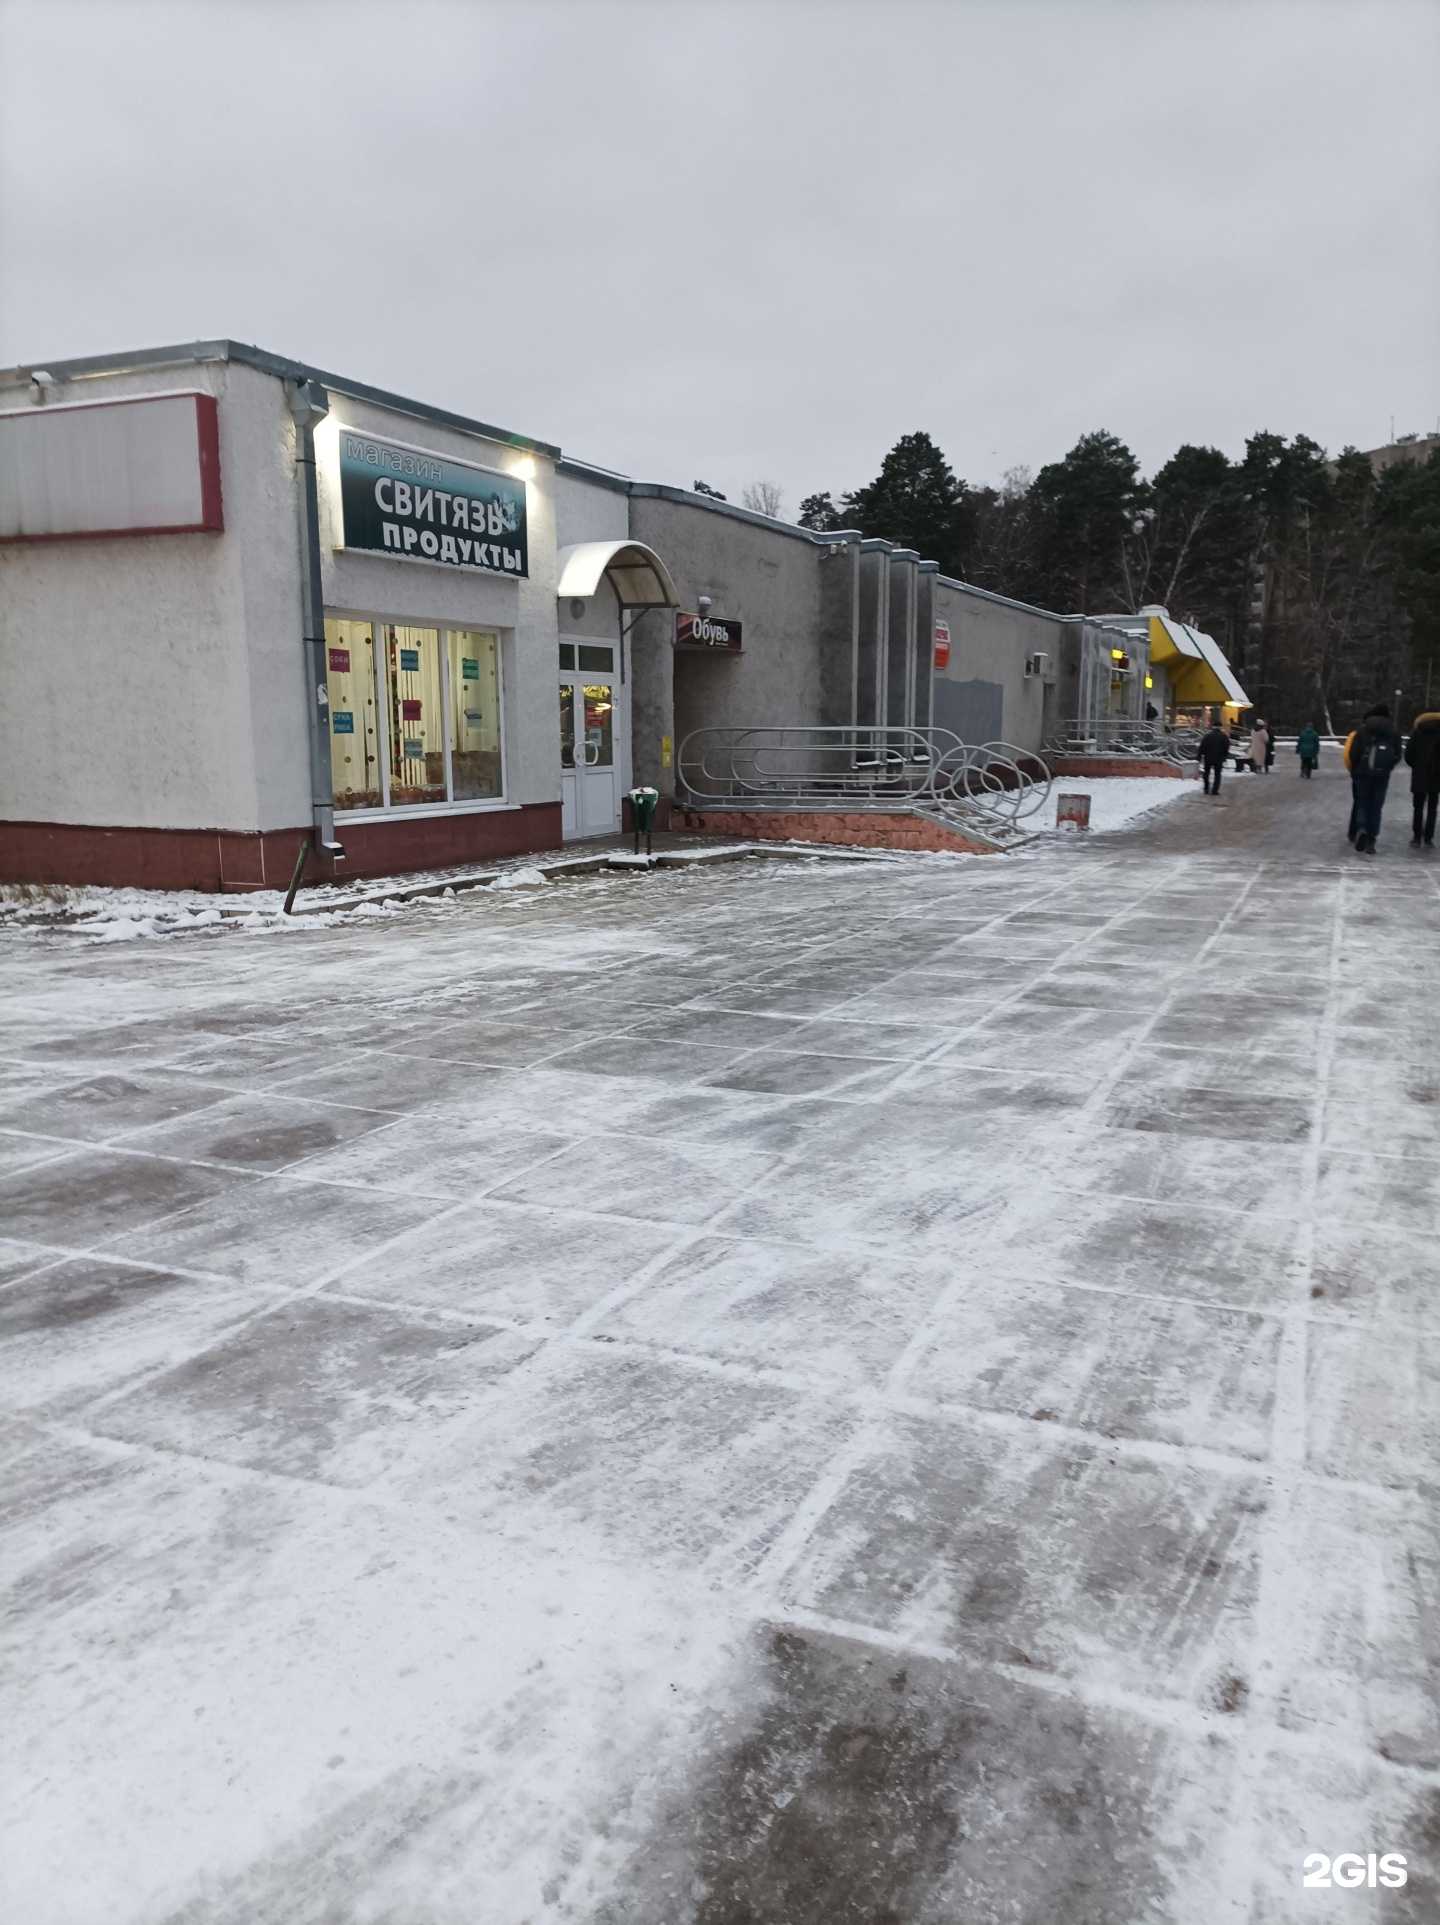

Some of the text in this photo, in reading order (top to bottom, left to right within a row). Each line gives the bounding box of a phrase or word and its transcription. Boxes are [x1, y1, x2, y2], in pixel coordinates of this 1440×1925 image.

[374, 476, 503, 536] СВИТЯЗЬ
[382, 521, 523, 571] ПРОДУКТЫ
[692, 616, 729, 646] Обувь
